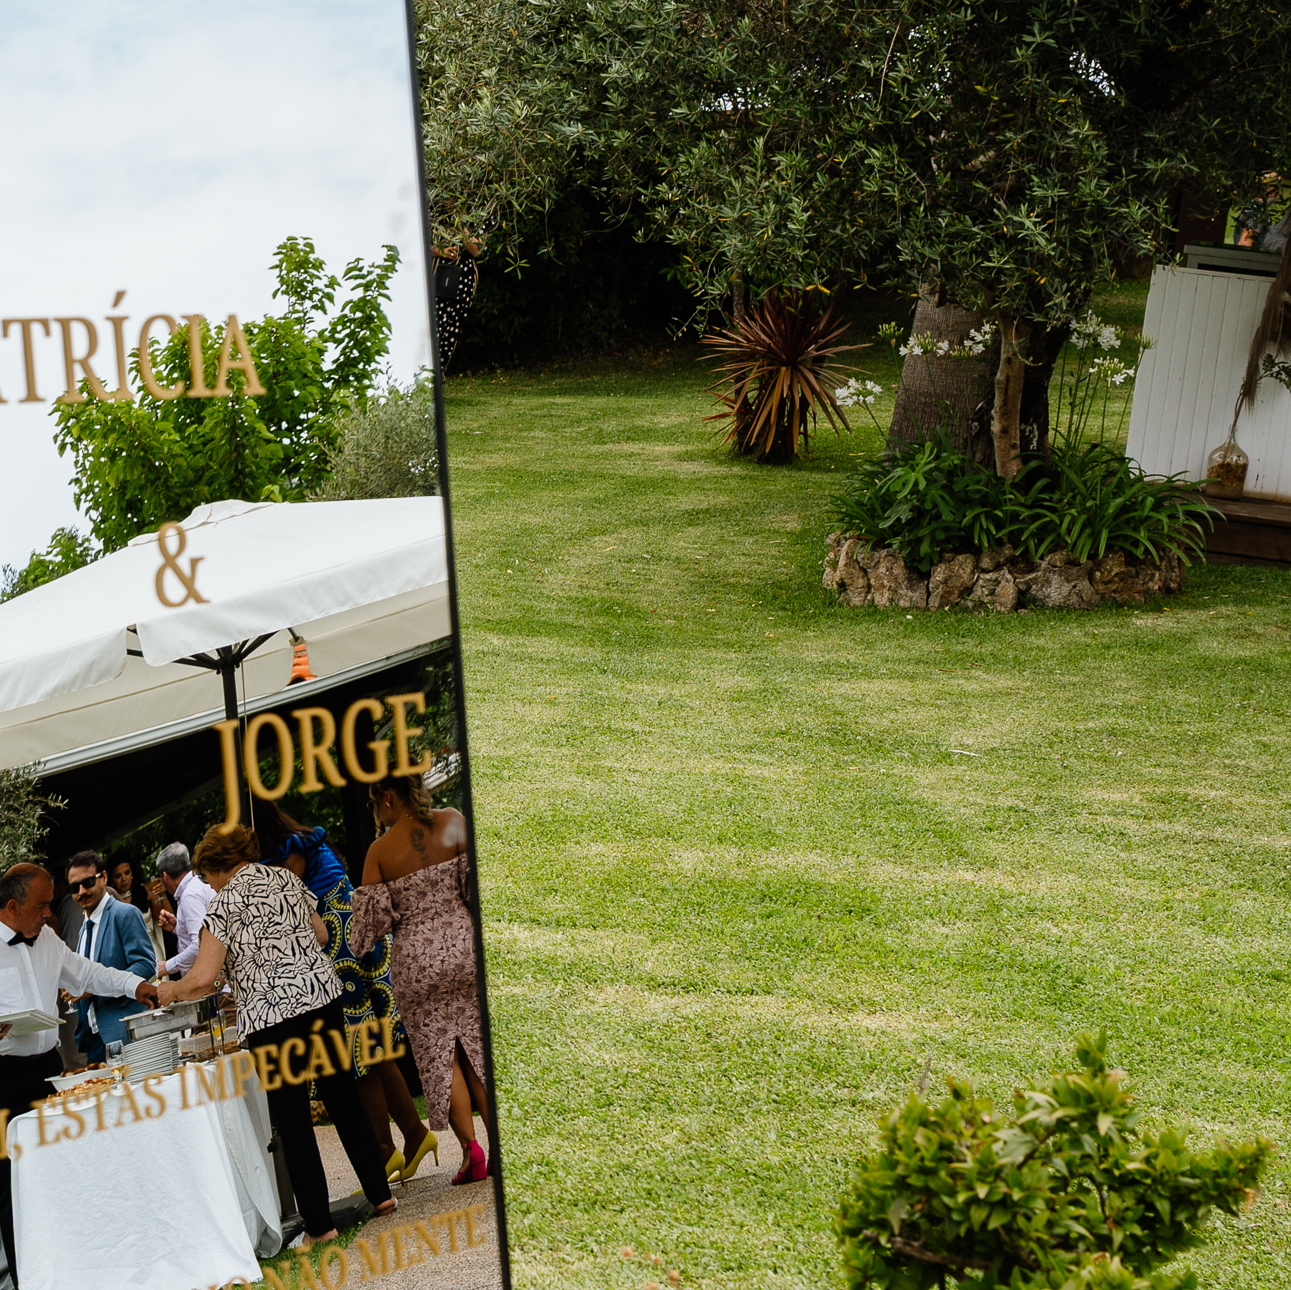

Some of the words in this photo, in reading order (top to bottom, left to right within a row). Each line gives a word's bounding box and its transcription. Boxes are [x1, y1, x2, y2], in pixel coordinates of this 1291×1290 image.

[155, 521, 210, 608] &
[215, 692, 432, 835] JORGE
[177, 1018, 406, 1110] IMPECÁVEL
[357, 1203, 487, 1282] MENTE
